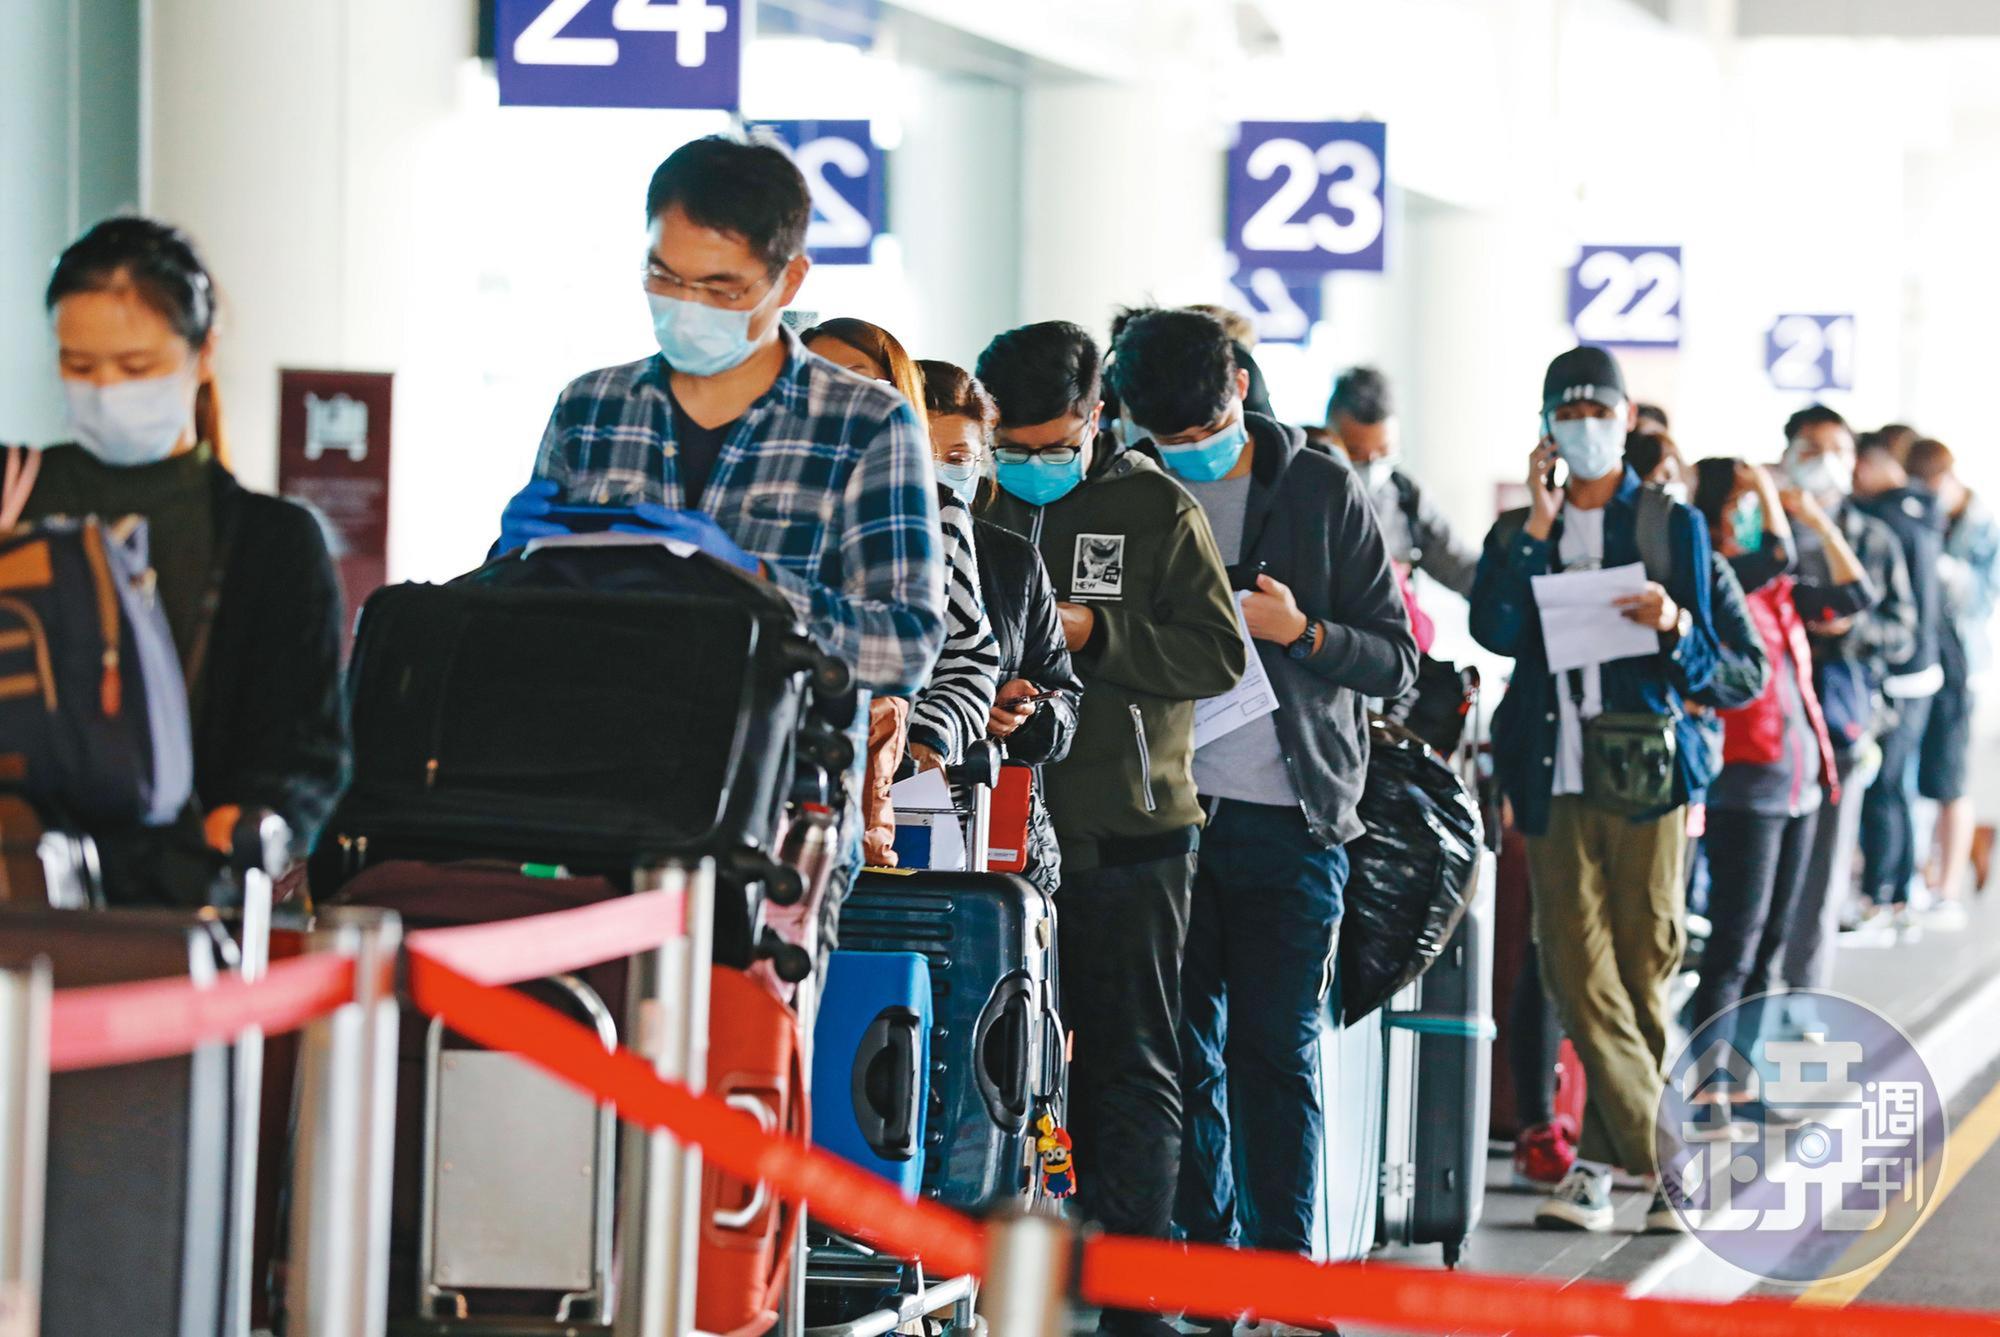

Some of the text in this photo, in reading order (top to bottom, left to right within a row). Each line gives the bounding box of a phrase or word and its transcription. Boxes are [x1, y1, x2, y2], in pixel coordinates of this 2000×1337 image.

[1241, 138, 1383, 253] 23
[1575, 251, 1681, 341] 22
[1770, 315, 1853, 389] 21
